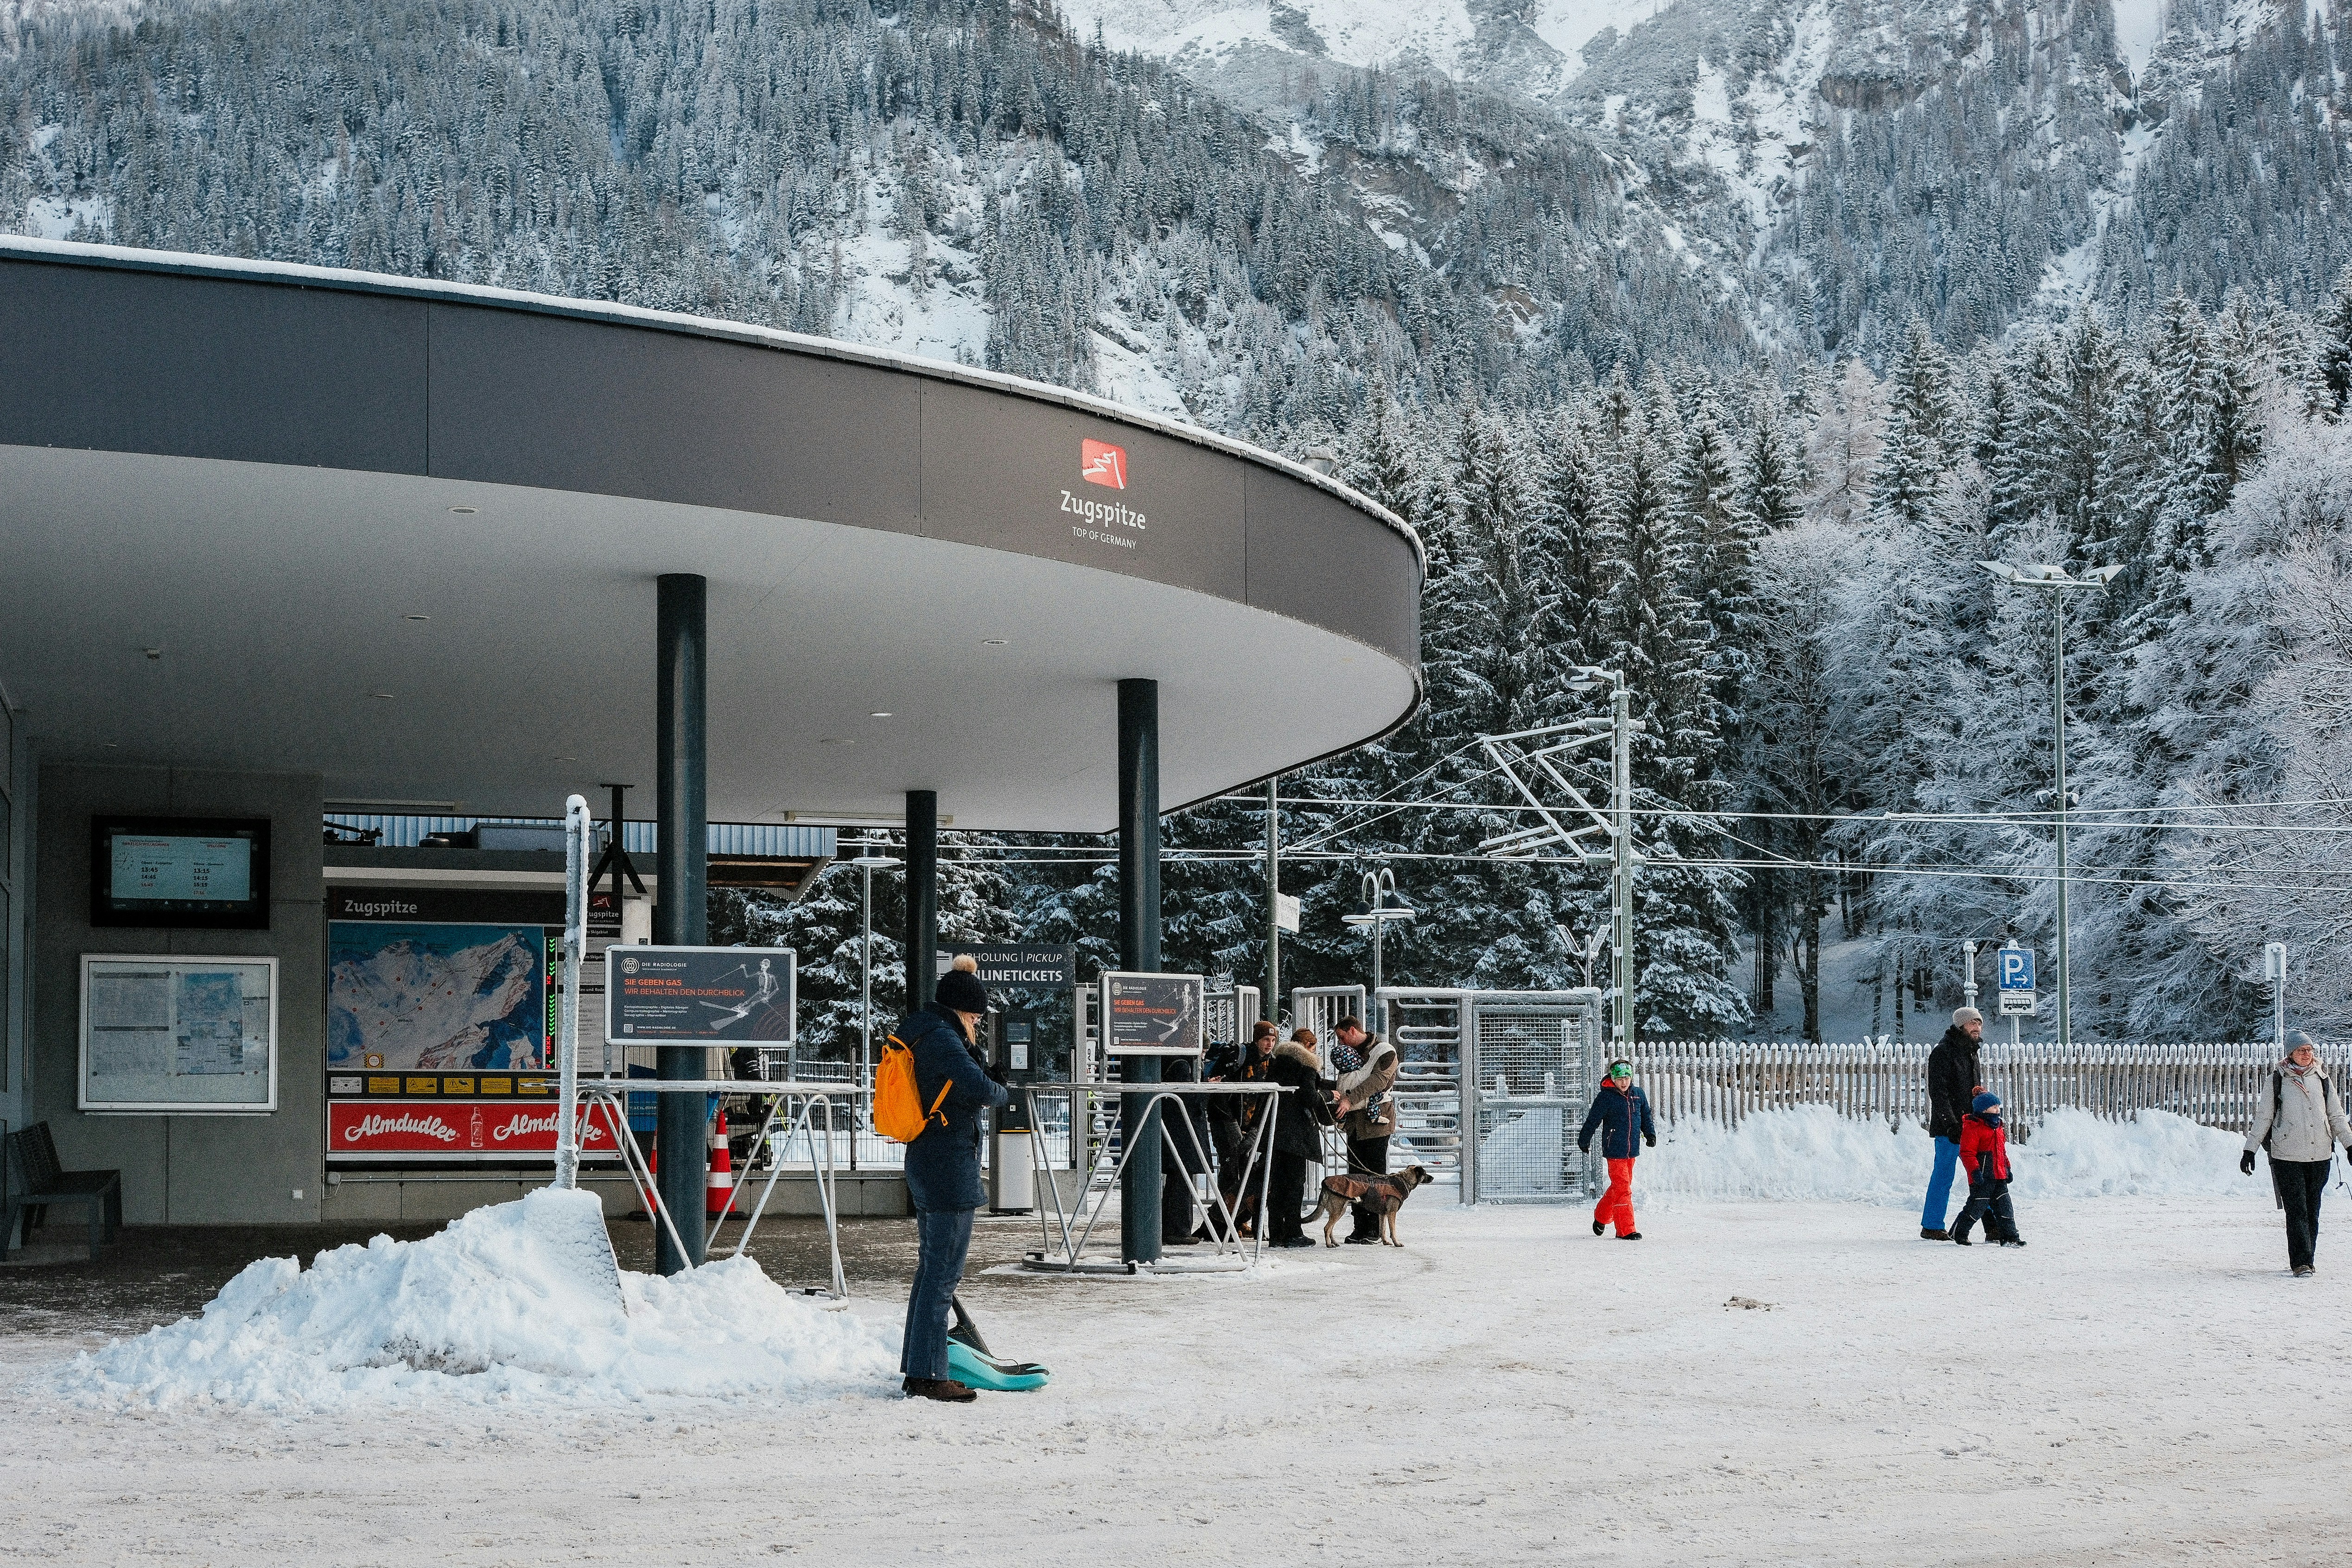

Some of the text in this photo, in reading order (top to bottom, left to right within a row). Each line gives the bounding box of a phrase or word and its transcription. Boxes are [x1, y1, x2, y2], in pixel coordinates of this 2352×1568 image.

[1061, 489, 1146, 529] Zugspitze
[1072, 526, 1137, 549] TOP OF GERMANY
[345, 900, 418, 916] Zugspitze
[961, 953, 1062, 962] HOLUNG PICKUP
[2005, 954, 2024, 984] P
[344, 1112, 457, 1142] Almdudler
